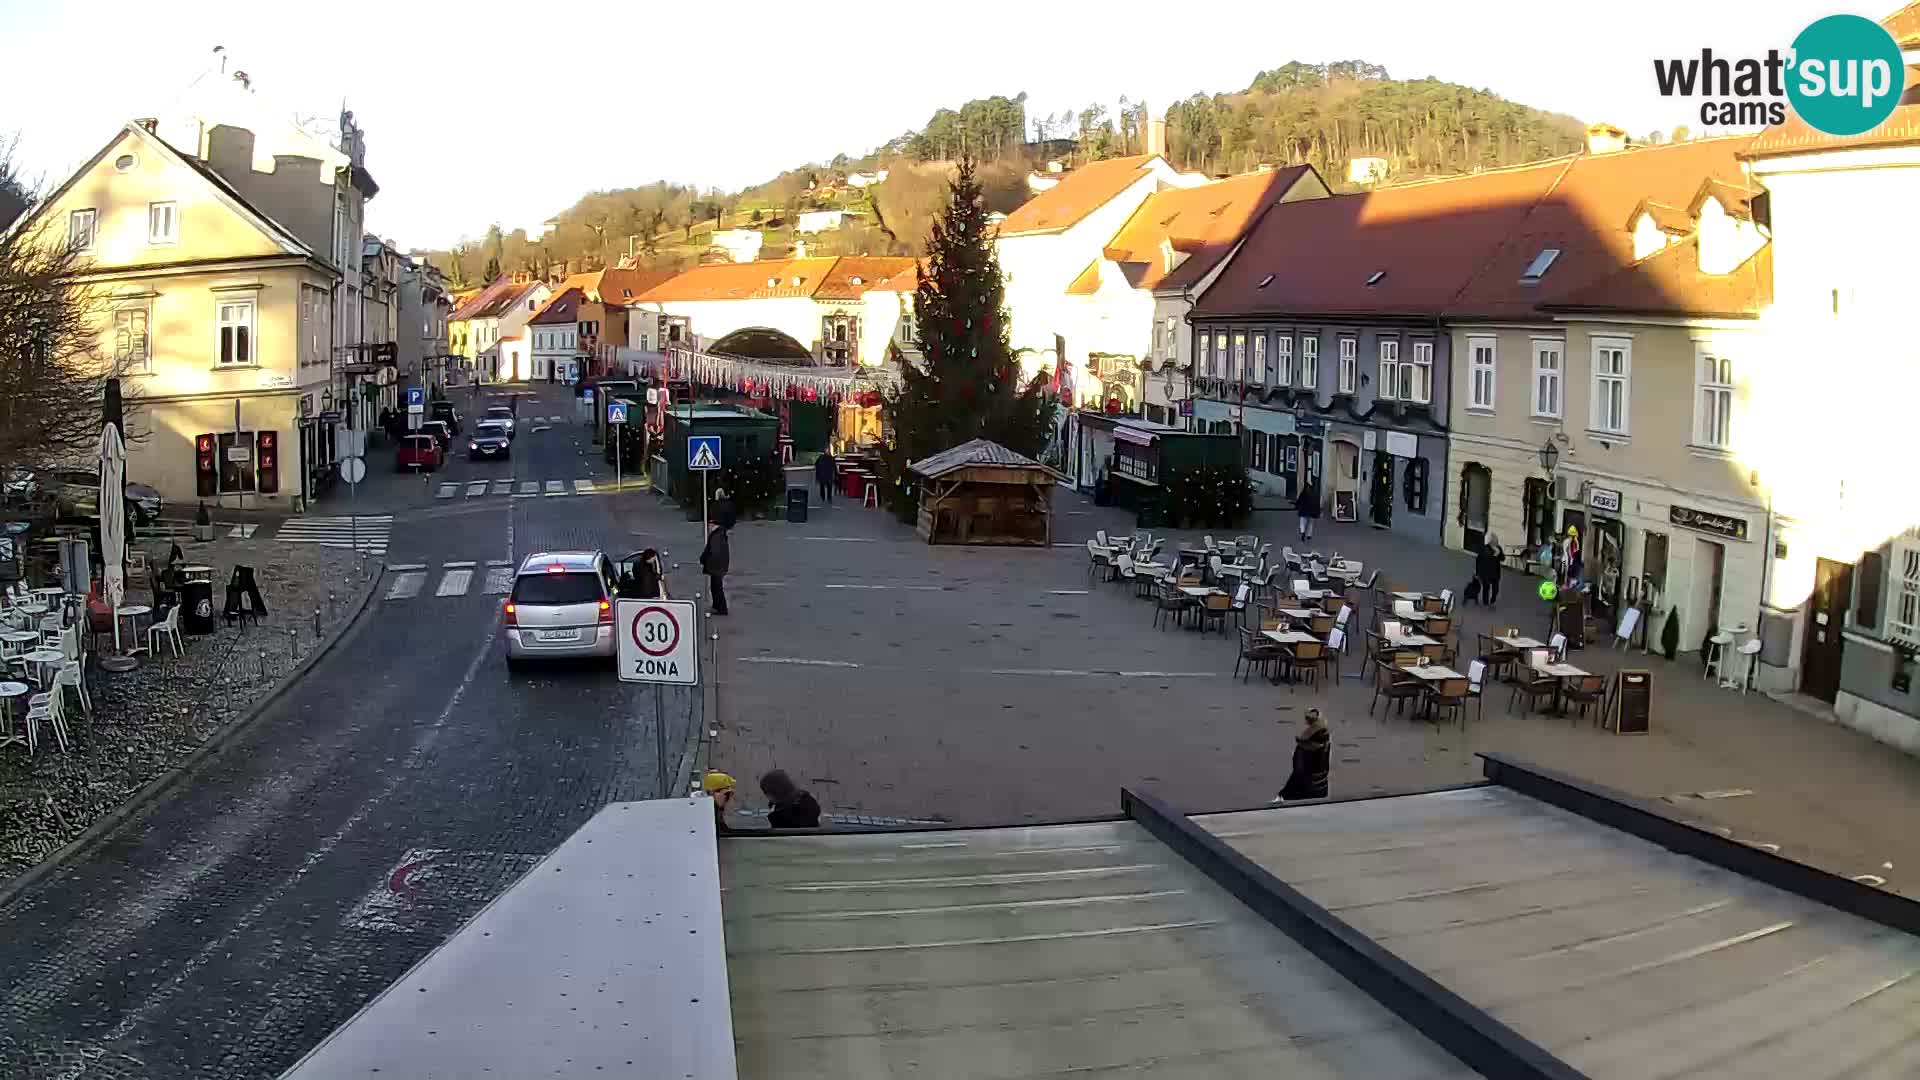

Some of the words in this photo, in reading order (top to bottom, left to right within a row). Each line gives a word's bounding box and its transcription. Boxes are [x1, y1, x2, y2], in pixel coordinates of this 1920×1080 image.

[412, 391, 420, 402] P
[645, 622, 668, 643] 30
[635, 660, 678, 676] ZONA
